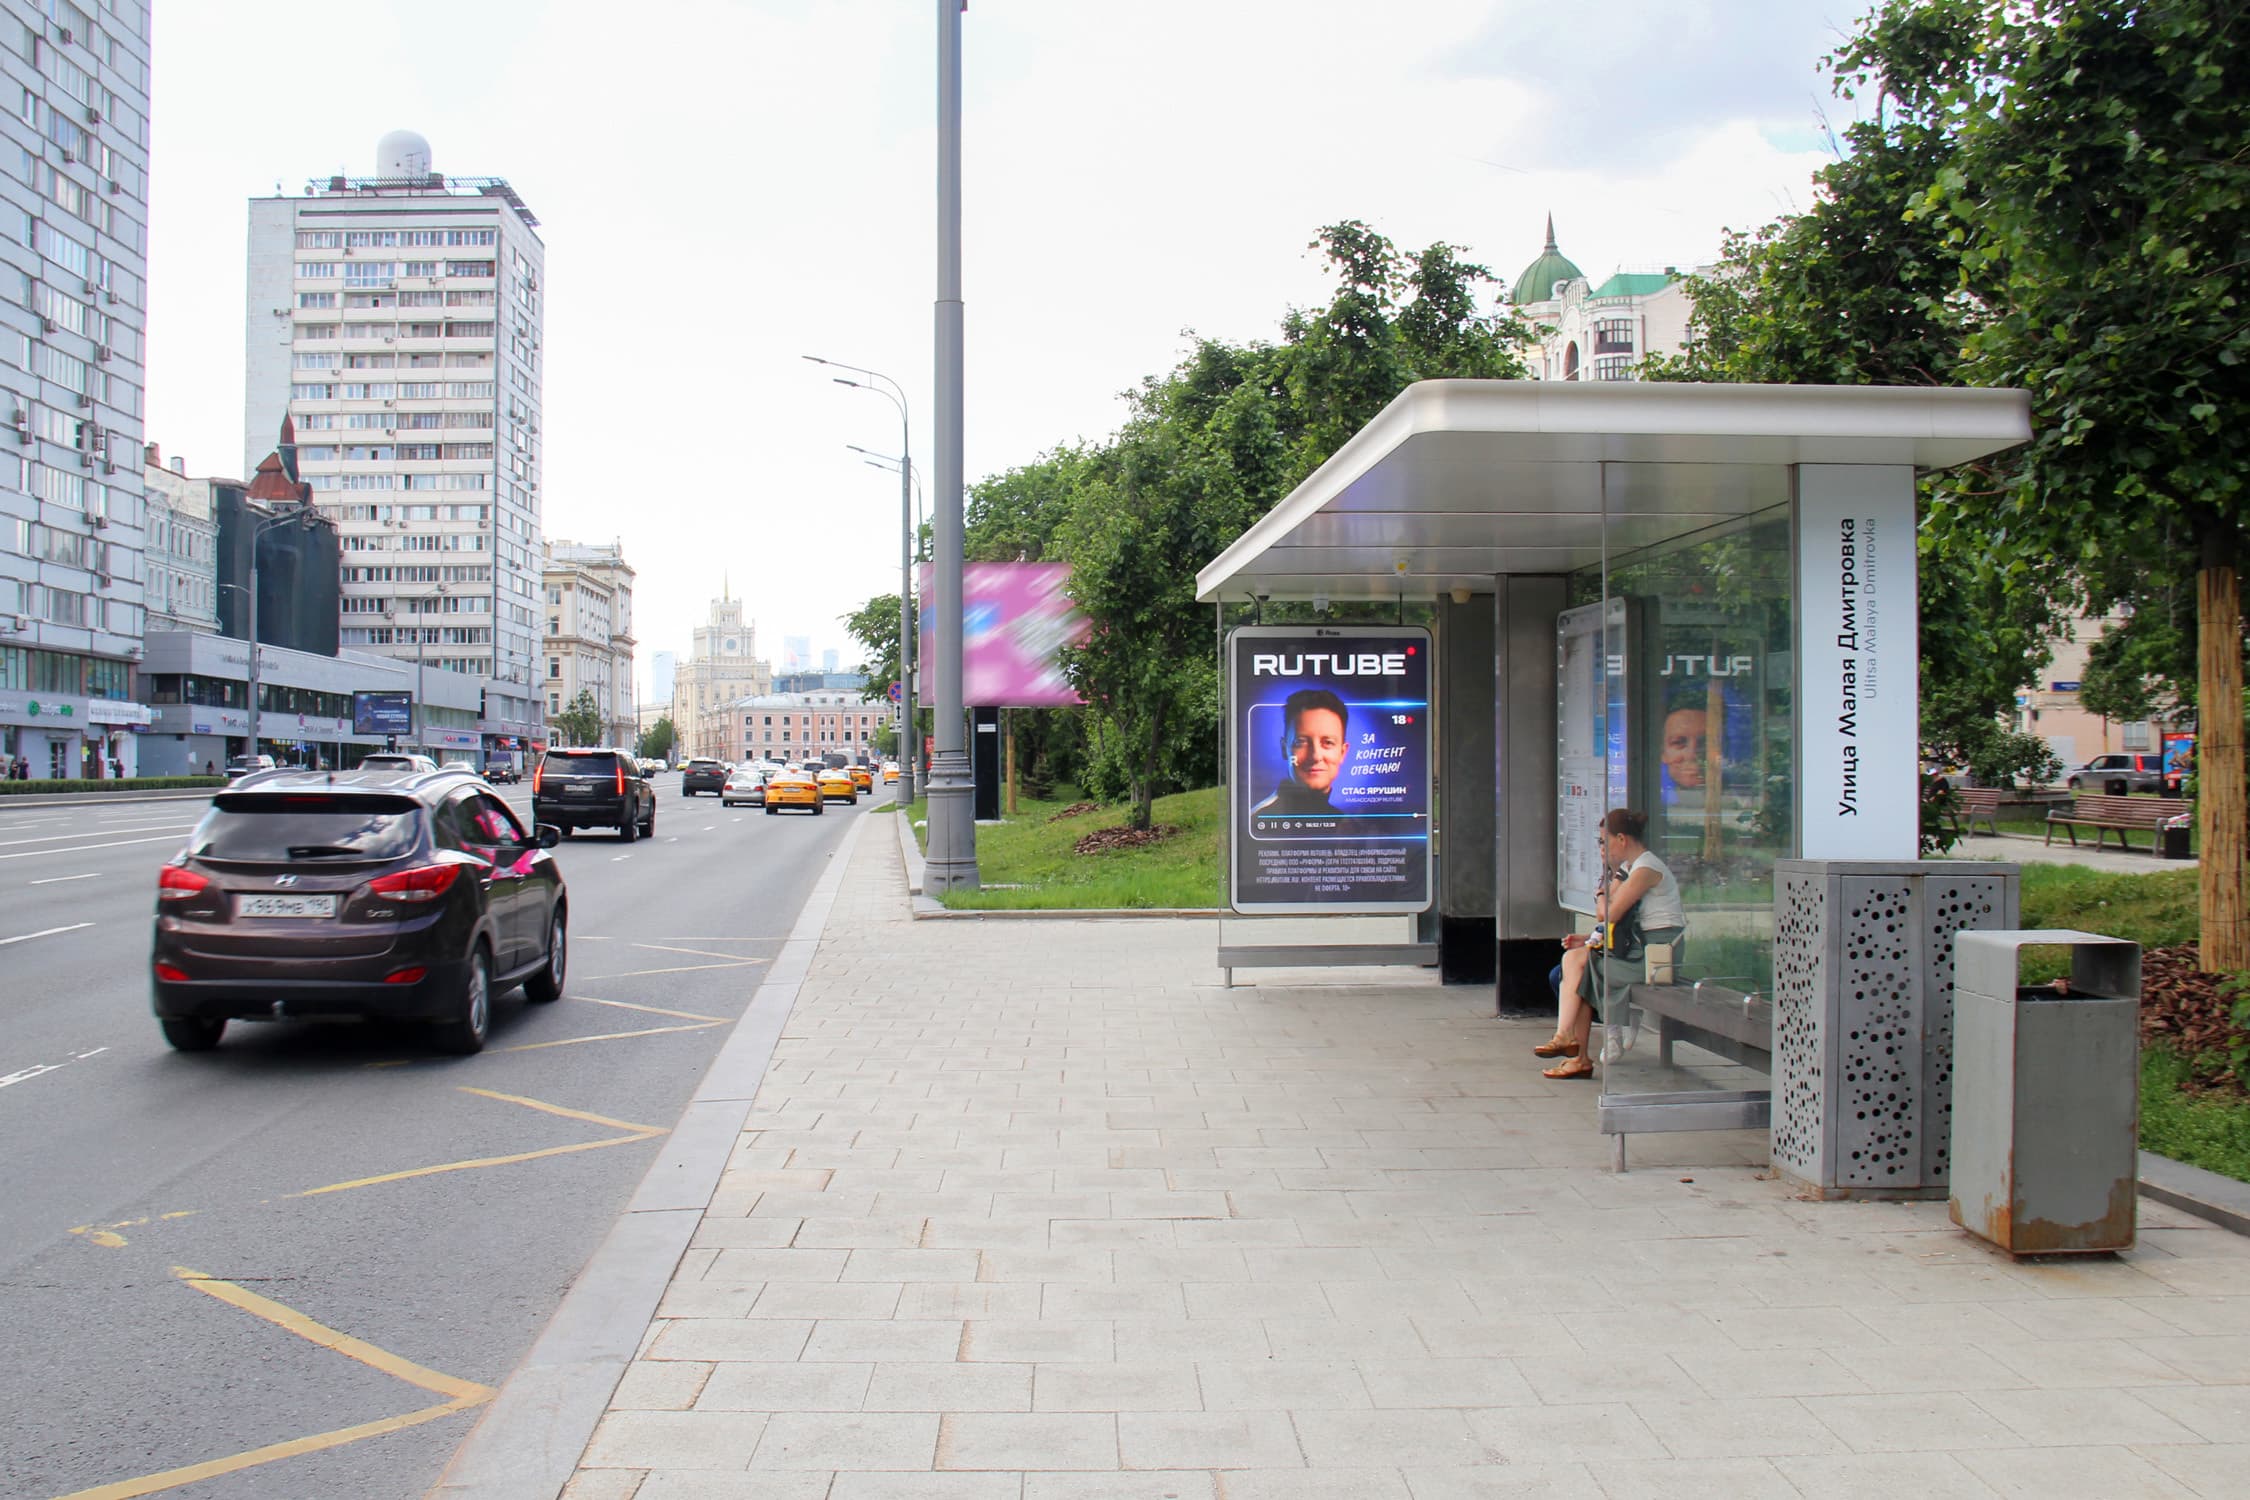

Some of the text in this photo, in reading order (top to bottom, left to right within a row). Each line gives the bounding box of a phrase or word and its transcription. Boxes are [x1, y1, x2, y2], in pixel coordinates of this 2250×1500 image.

[1862, 518, 1879, 699] Ulitsa Malaya Dmitrovka
[1253, 654, 1406, 676] RUTUBE
[1838, 518, 1859, 816] Улица Малая Дмитровка
[1361, 733, 1376, 744] ЗА
[1355, 746, 1407, 761] КОНТЕНТ
[1350, 761, 1401, 776] ОТВЕЧАЮ!
[1341, 786, 1407, 795] СТАС ЯРУШИН
